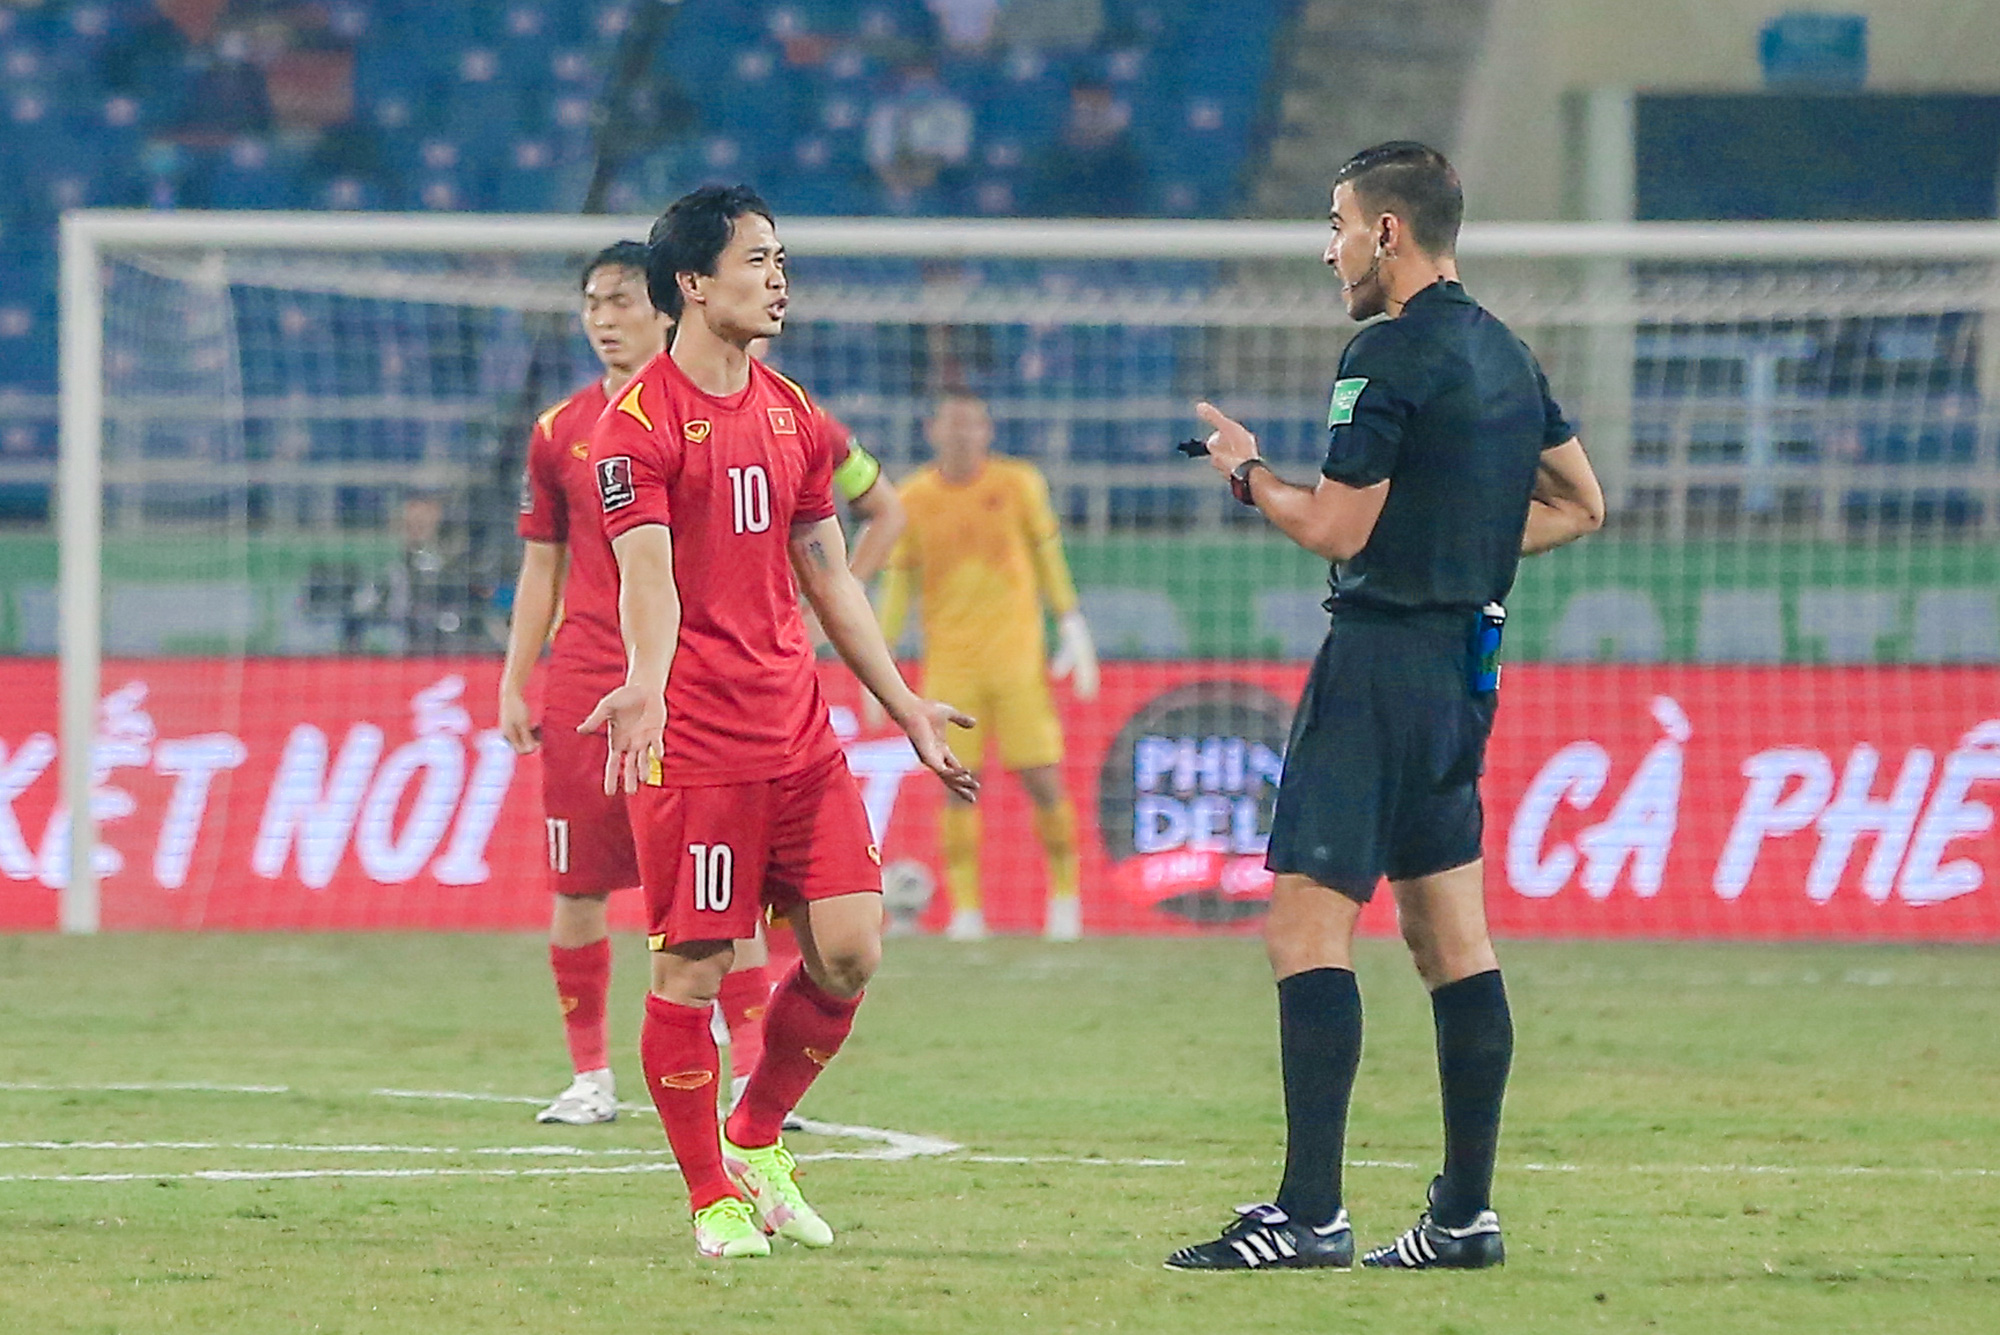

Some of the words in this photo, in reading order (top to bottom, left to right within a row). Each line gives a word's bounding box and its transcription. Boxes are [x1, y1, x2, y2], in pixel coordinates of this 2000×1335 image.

[727, 465, 771, 534] 10
[251, 674, 519, 889] NỐI
[1507, 695, 1692, 899] CÀ
[1712, 719, 2000, 906] PHÊ
[545, 818, 569, 874] 11
[1135, 795, 1276, 855] DEL
[689, 844, 732, 911] 10
